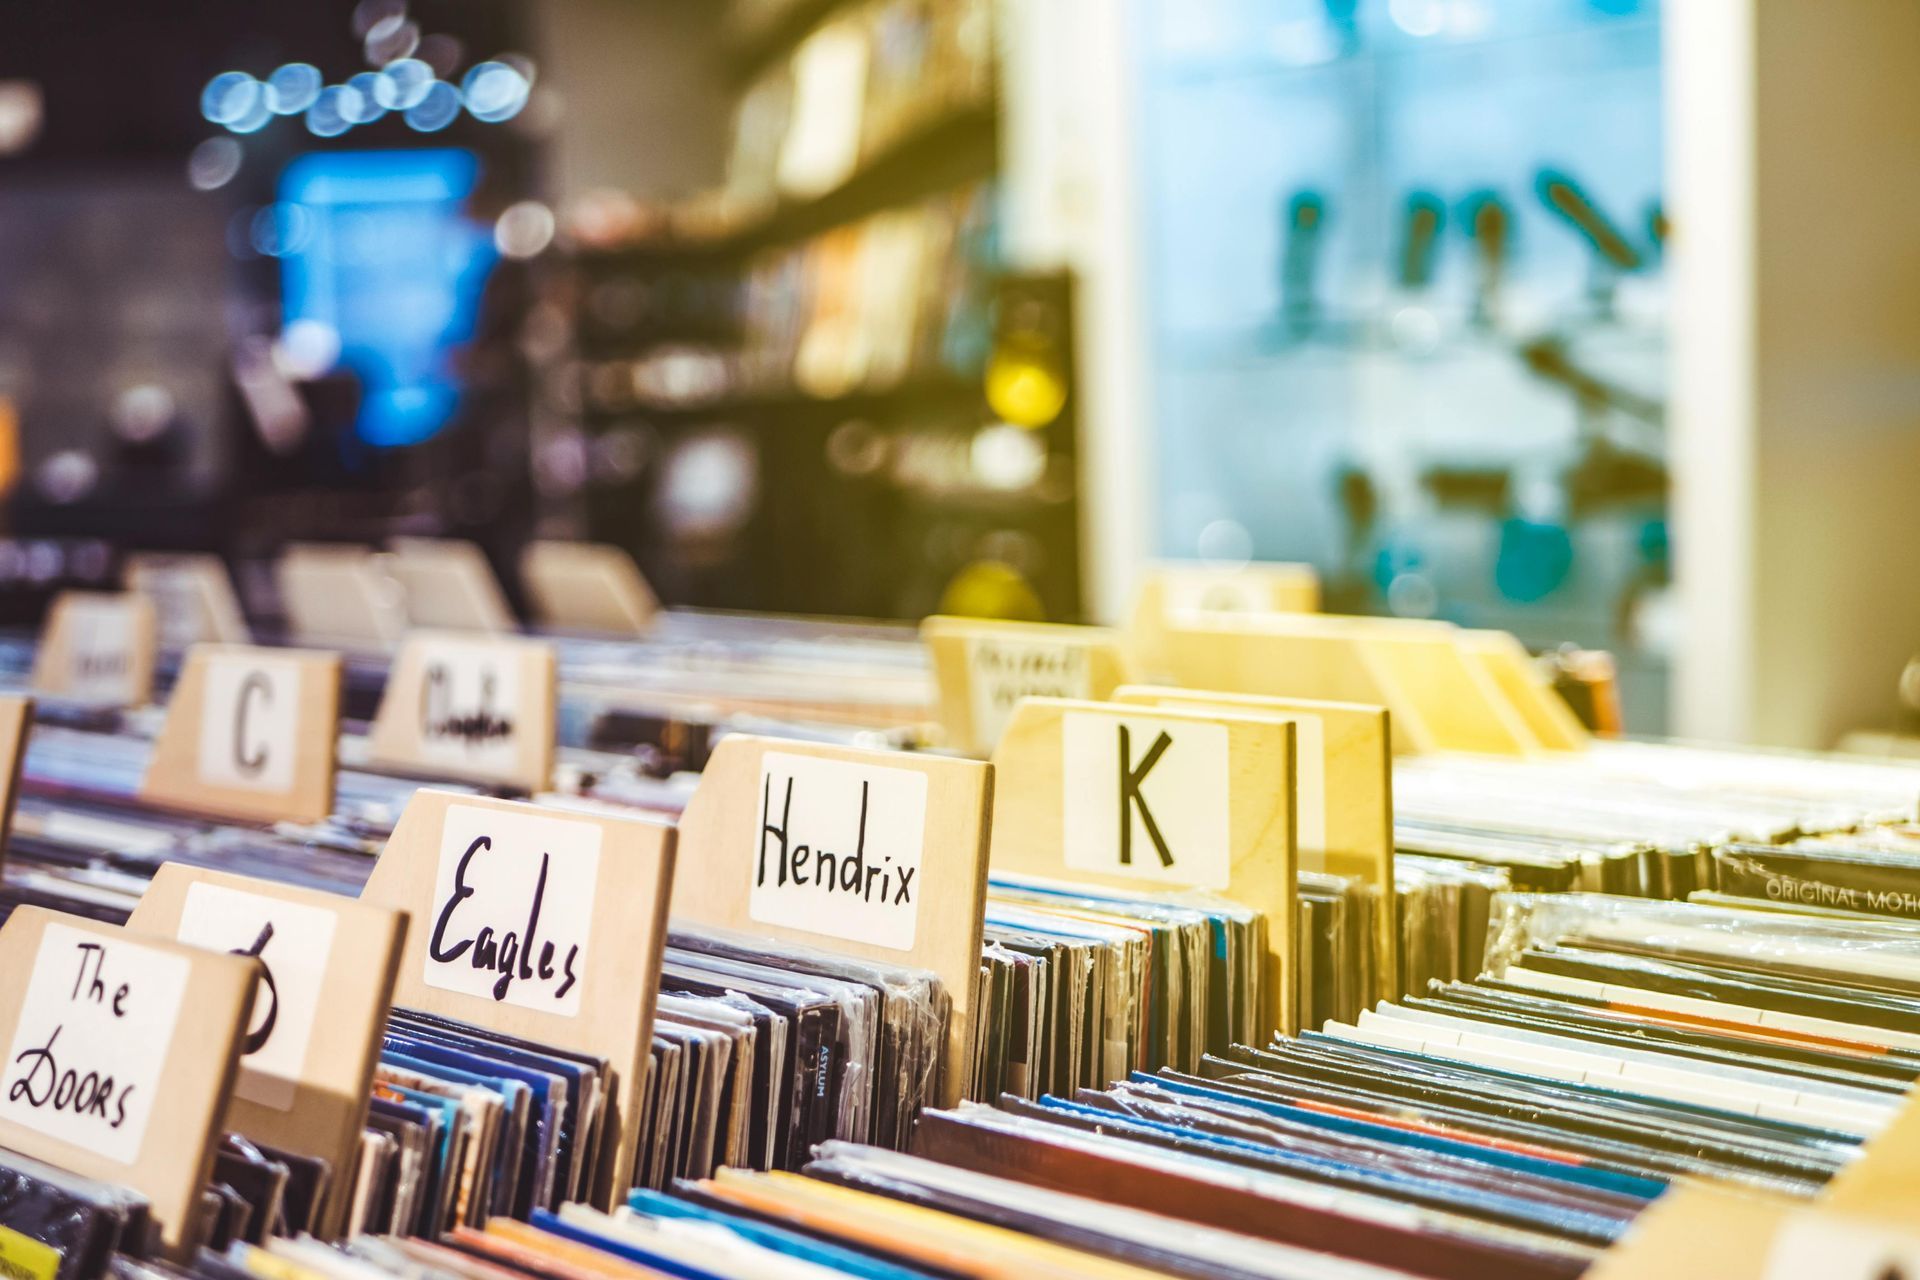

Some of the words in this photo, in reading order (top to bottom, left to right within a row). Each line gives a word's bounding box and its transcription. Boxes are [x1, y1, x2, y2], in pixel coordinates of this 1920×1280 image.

[233, 671, 273, 777] C
[757, 773, 916, 906] Hendrix
[1119, 724, 1174, 868] K
[429, 834, 579, 1002] Eagles
[1766, 878, 1860, 908] ORIGINAL
[71, 943, 130, 1018] The
[816, 1046, 830, 1097] ASYLUM
